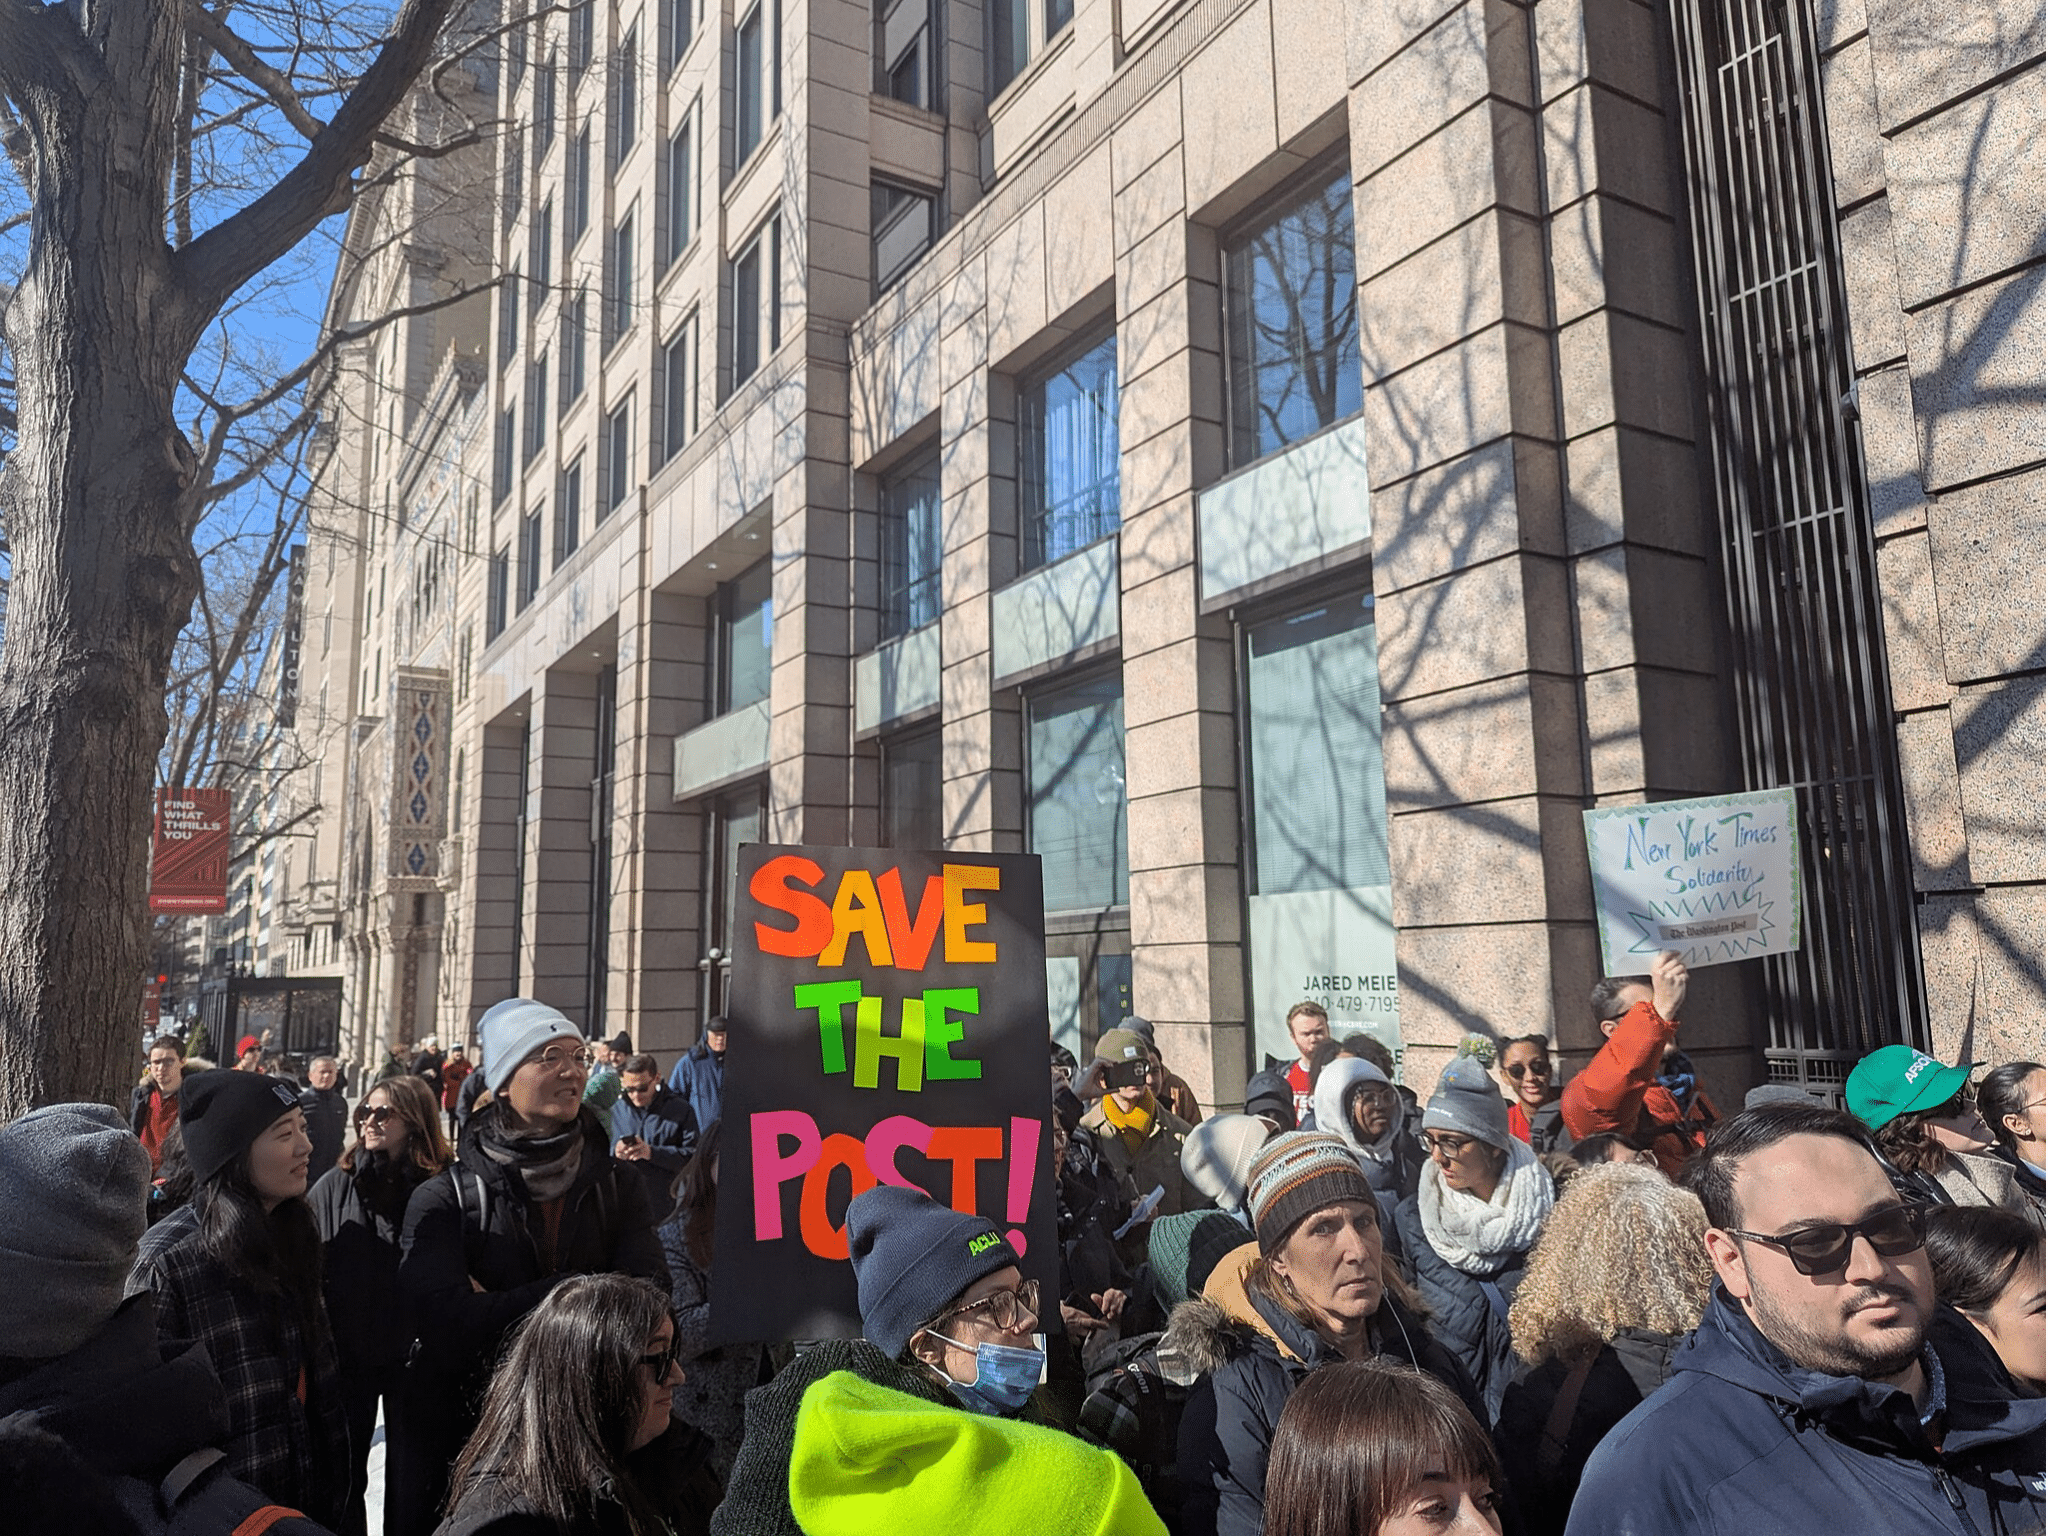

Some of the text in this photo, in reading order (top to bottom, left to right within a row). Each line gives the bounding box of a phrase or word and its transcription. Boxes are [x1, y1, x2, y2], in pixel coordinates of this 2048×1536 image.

[164, 800, 196, 810] FIND
[164, 810, 204, 820] WHAT
[164, 820, 221, 831] THRILLS
[164, 831, 192, 840] YOU
[1624, 811, 1778, 871] New York Times
[1663, 858, 1765, 902] Solidarity
[749, 855, 1001, 971] SAVE
[1670, 920, 1746, 939] The Washington Post
[1303, 975, 1352, 991] JARED
[794, 980, 983, 1092] THE
[750, 1110, 1042, 1260] POST!
[968, 1231, 1001, 1257] ACLU
[1127, 1362, 1149, 1394] Canon
